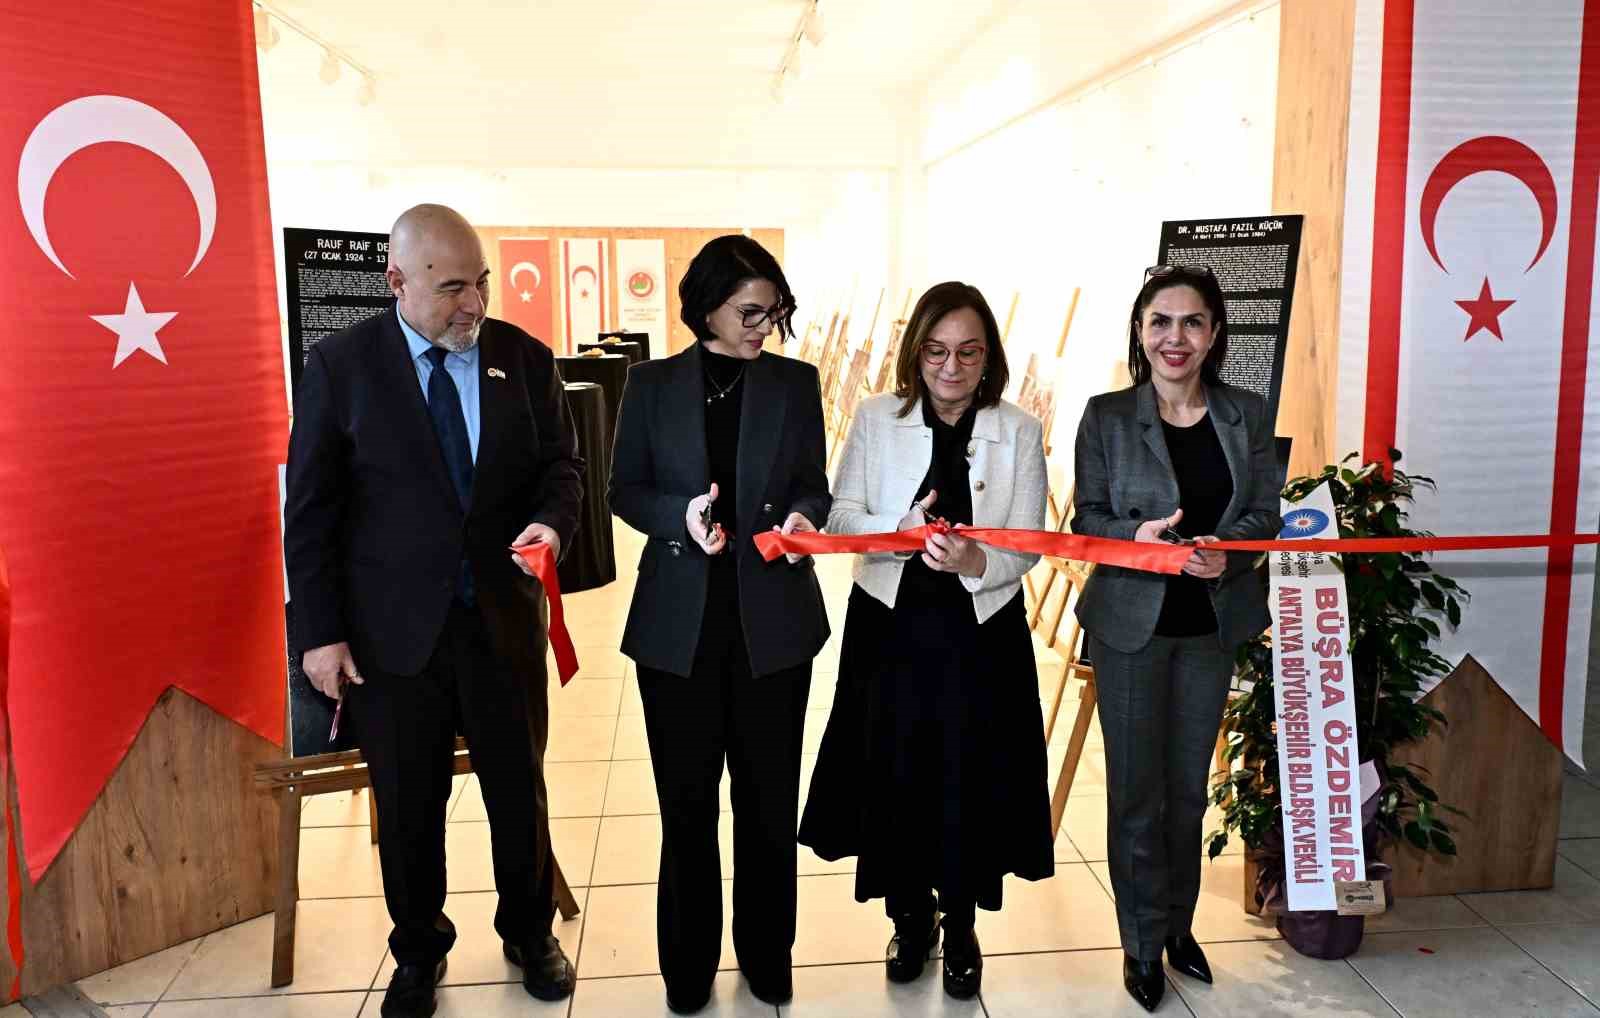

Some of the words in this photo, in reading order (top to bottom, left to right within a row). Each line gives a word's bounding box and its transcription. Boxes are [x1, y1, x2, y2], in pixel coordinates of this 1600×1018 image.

[1178, 226, 1191, 235] DR.
[1195, 224, 1227, 233] MUSTAFA
[1231, 222, 1254, 232] FAZIL
[1258, 220, 1283, 231] KÜÇÜK
[304, 251, 318, 260] (27
[321, 252, 342, 261] OCAK
[345, 253, 364, 262] 1924
[376, 255, 386, 263] 13
[317, 238, 344, 249] RAUF
[349, 239, 371, 251] RAİF
[377, 242, 390, 252] DE
[1278, 551, 1294, 577] ediyesi
[1294, 551, 1312, 578] ükşehir
[1278, 586, 1305, 654] ANTALYA
[1312, 587, 1346, 709] BÜŞRA
[1278, 657, 1317, 759] BÜYÜKŞEHİR
[1324, 719, 1360, 881] ÖZDEMİR
